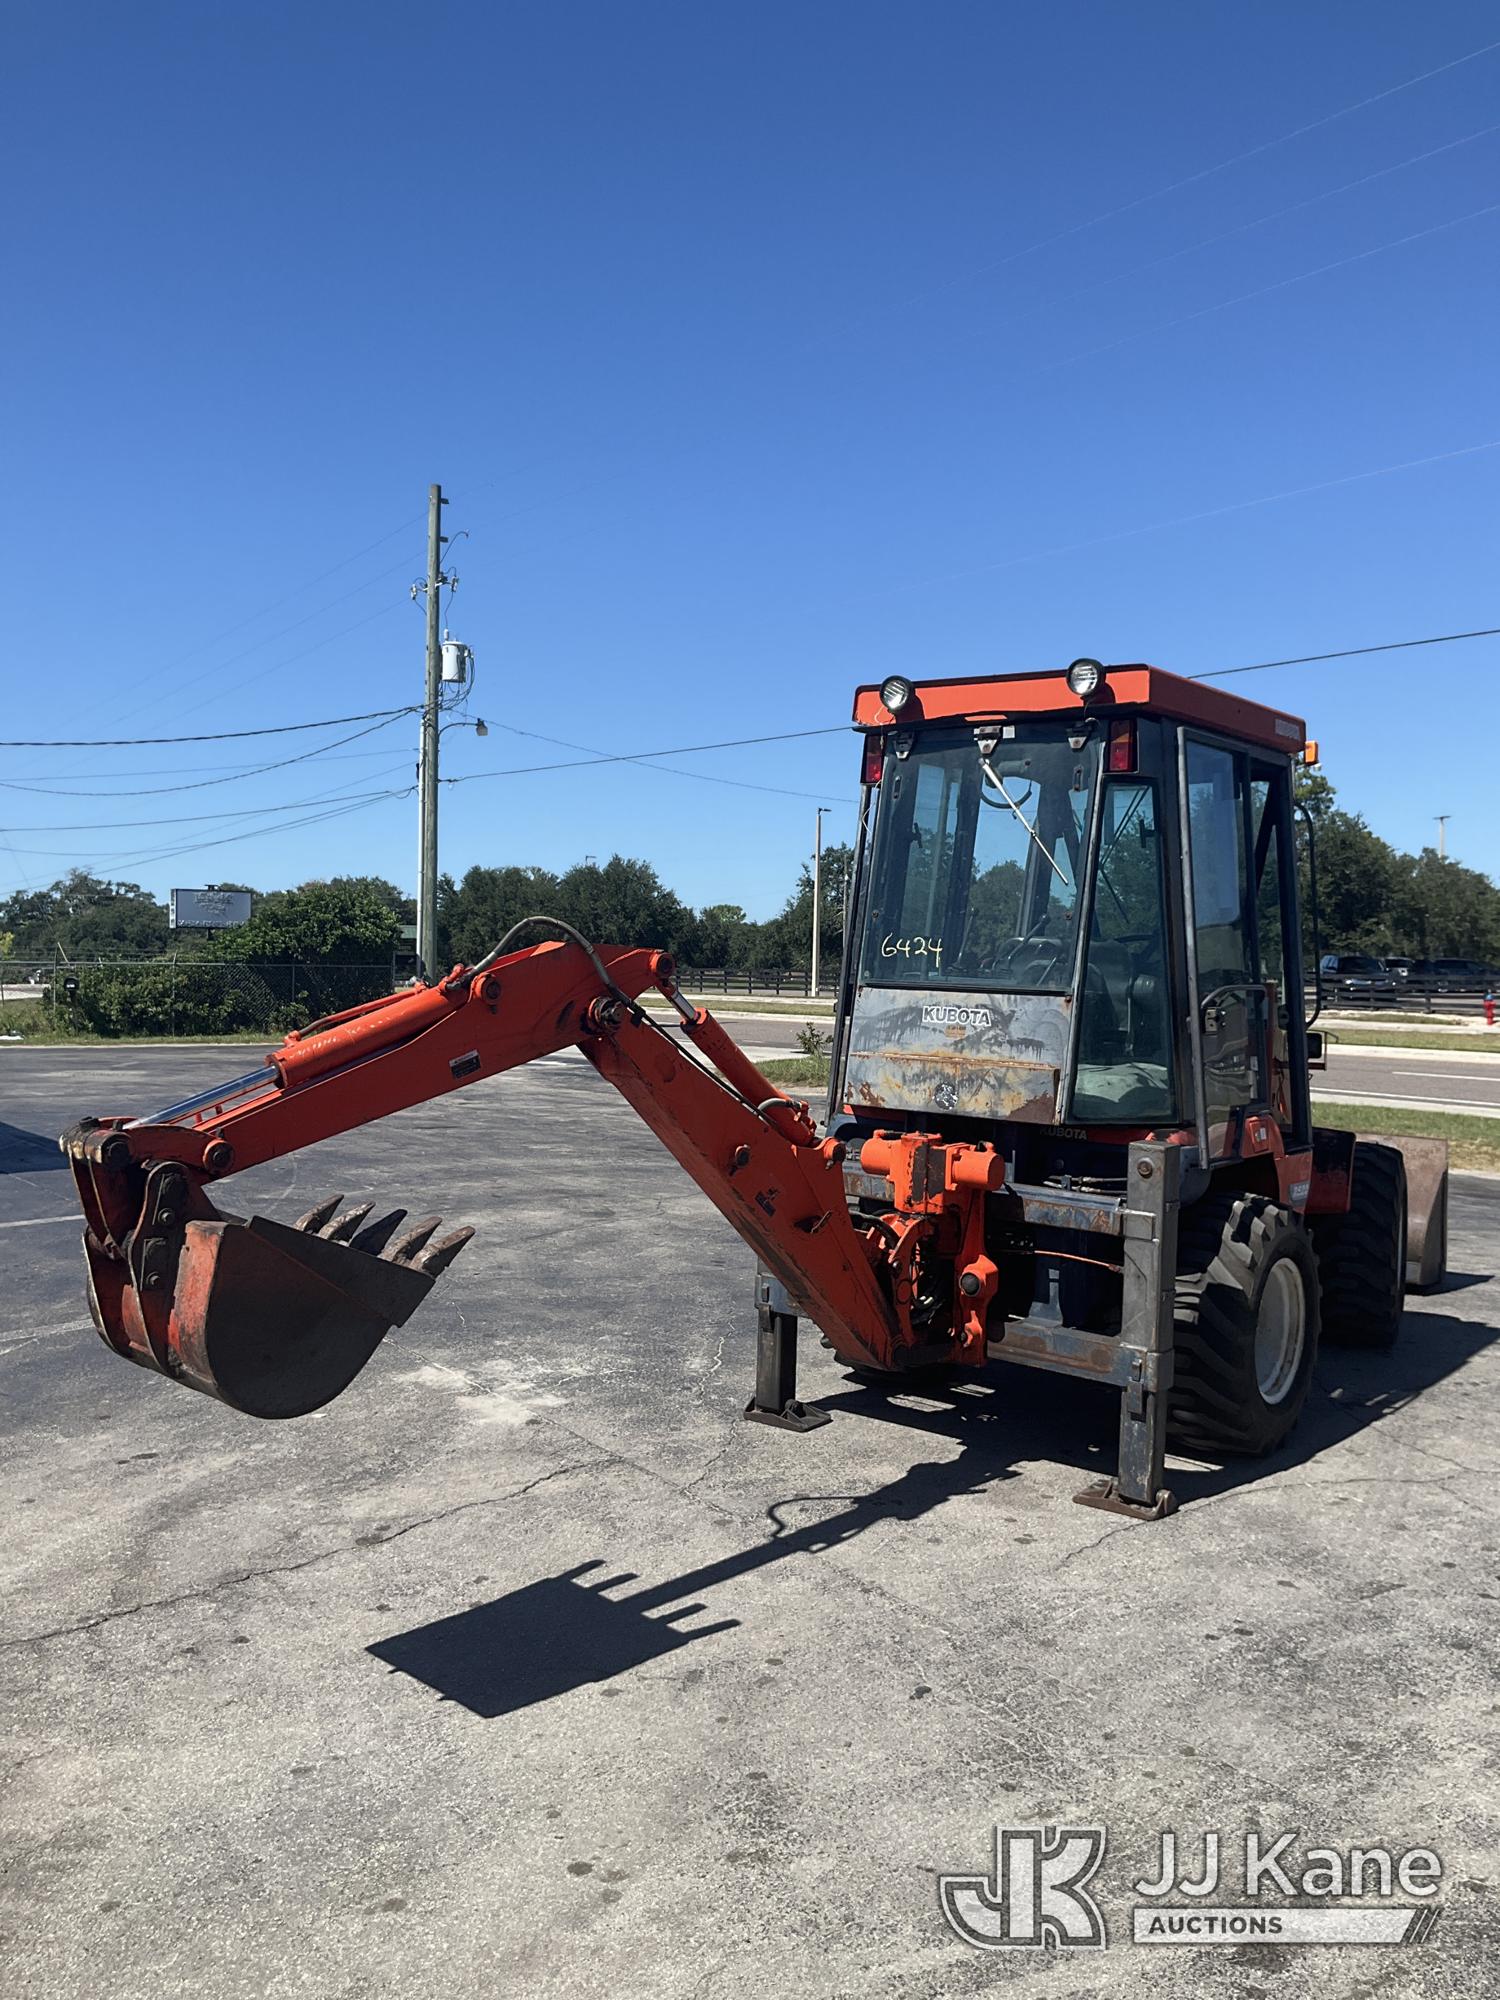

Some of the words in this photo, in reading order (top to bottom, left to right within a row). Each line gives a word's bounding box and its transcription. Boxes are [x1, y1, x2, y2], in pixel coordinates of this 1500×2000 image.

[881, 932, 943, 968] 6424
[922, 1006, 992, 1027] KUBOTA
[1040, 1126, 1087, 1140] KUBOTA
